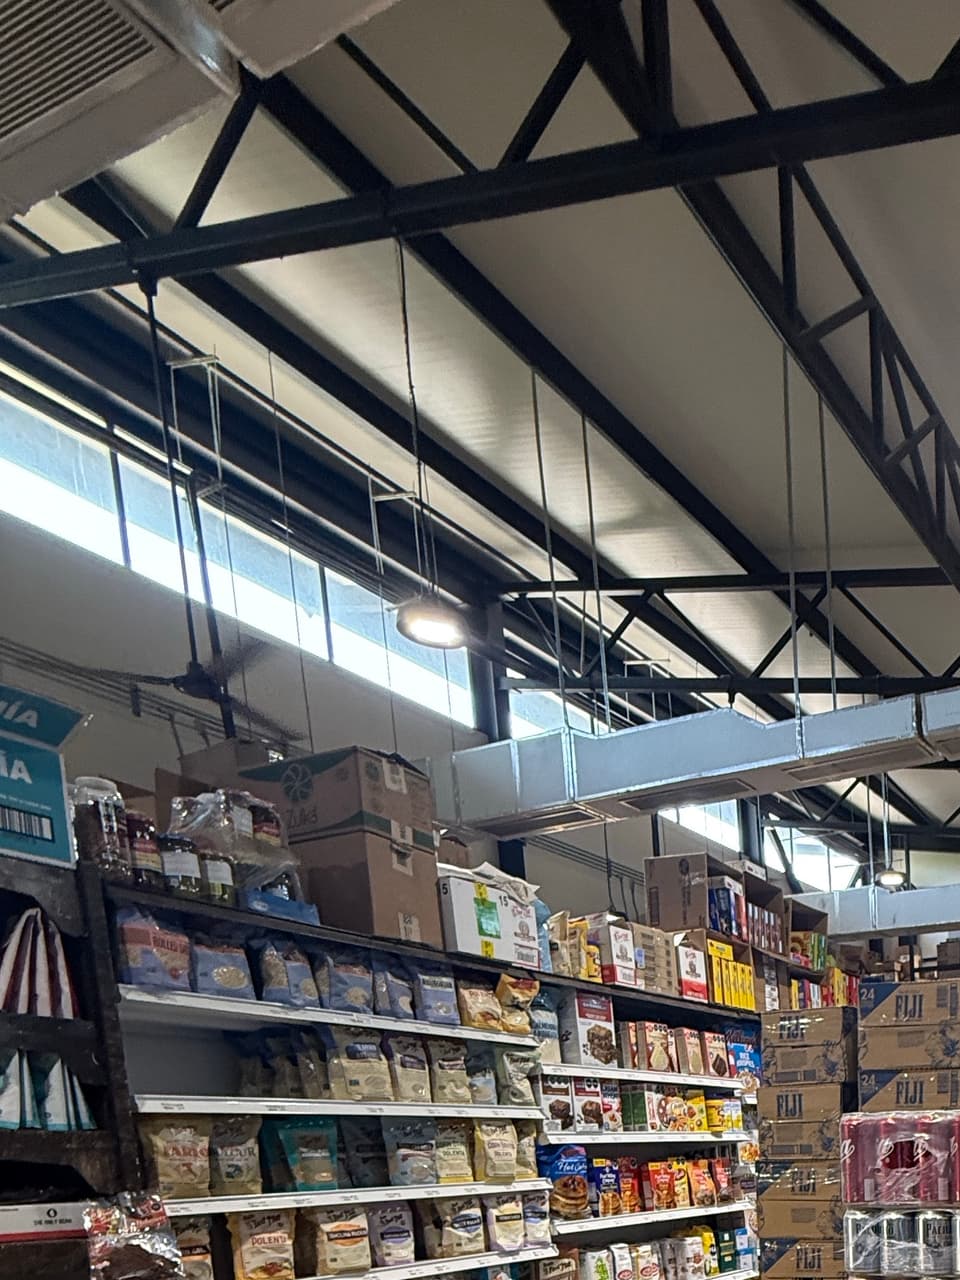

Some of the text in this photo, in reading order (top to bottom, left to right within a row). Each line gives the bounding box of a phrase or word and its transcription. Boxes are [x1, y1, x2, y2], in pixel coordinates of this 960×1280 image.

[860, 988, 875, 1001] 24
[895, 994, 924, 1019] FIJI
[861, 1074, 876, 1086] 24
[895, 1080, 924, 1105] FIJI
